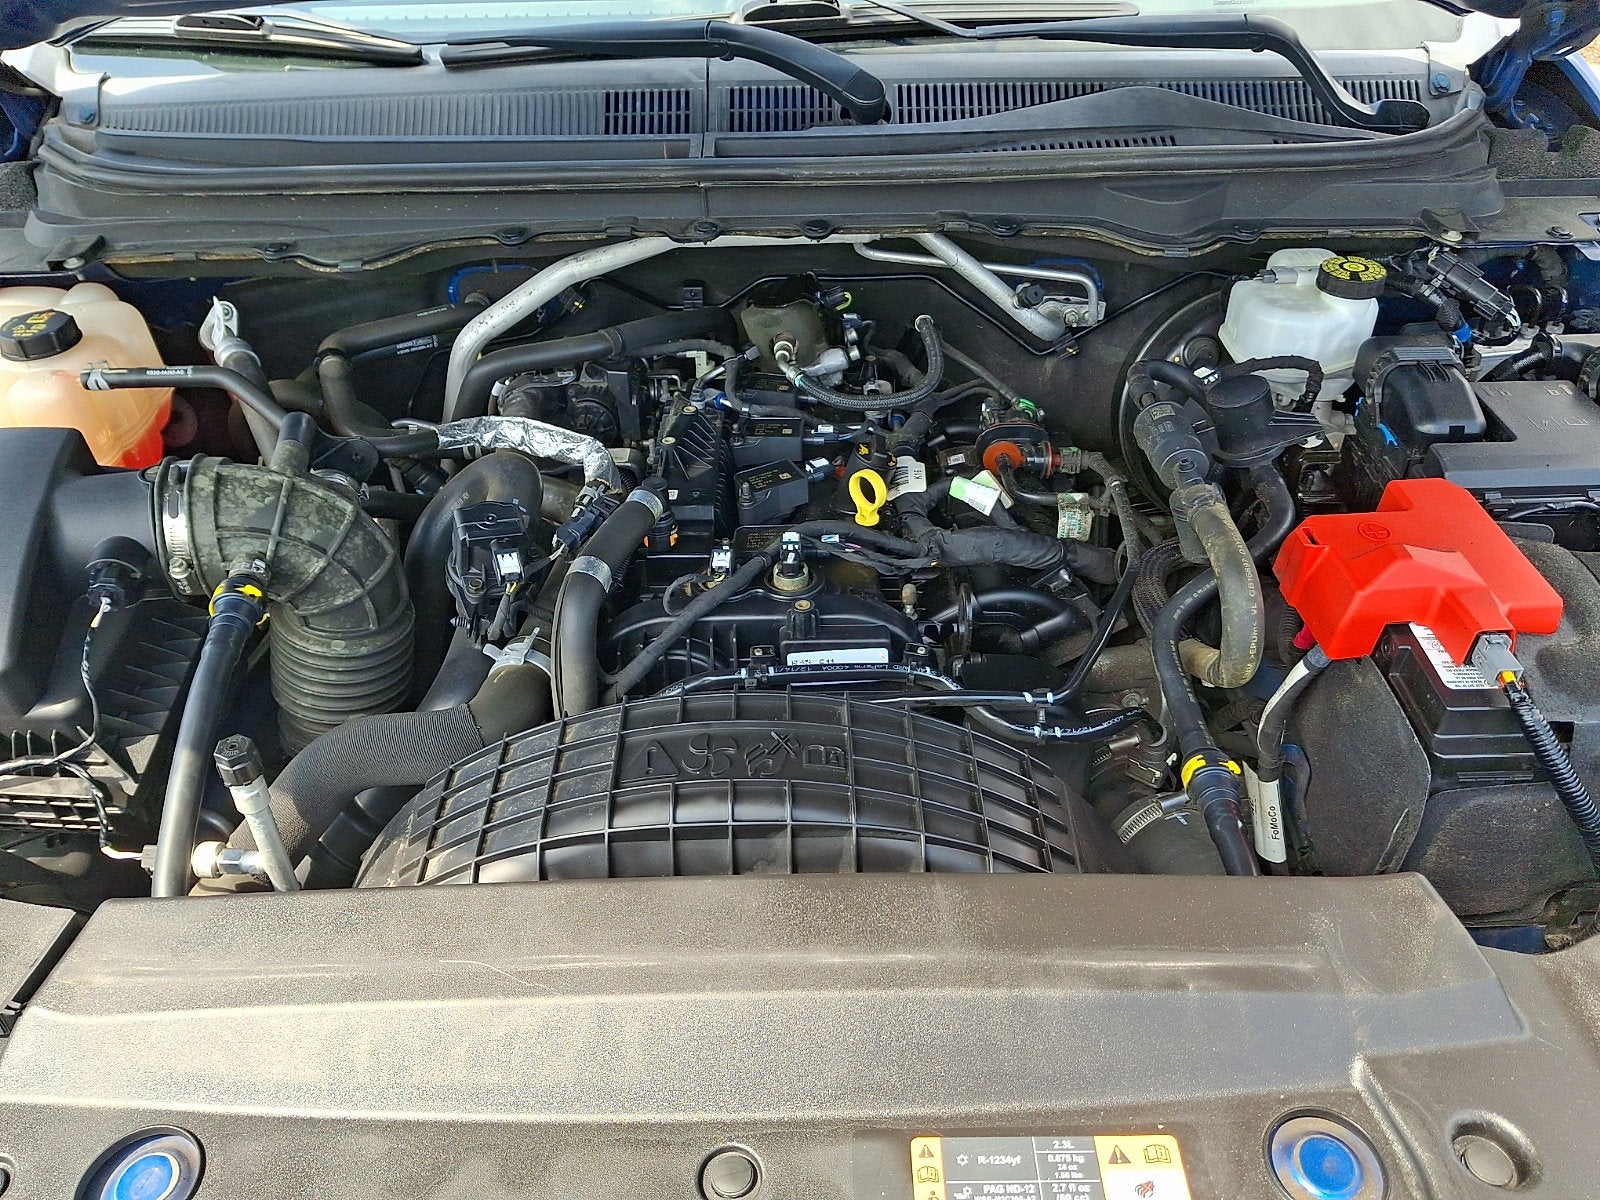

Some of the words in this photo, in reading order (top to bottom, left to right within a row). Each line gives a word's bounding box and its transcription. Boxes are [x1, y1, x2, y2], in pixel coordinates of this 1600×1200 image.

[1268, 805, 1280, 840] FoMoCo
[1052, 1140, 1075, 1149] 2.3L
[977, 1155, 1021, 1166] R-1234yf
[1073, 1154, 1085, 1164] kg
[983, 1184, 1005, 1194] PAG
[1006, 1184, 1035, 1194] ND-12
[1051, 1183, 1067, 1193] 2.7
[1077, 1184, 1091, 1193] oz
